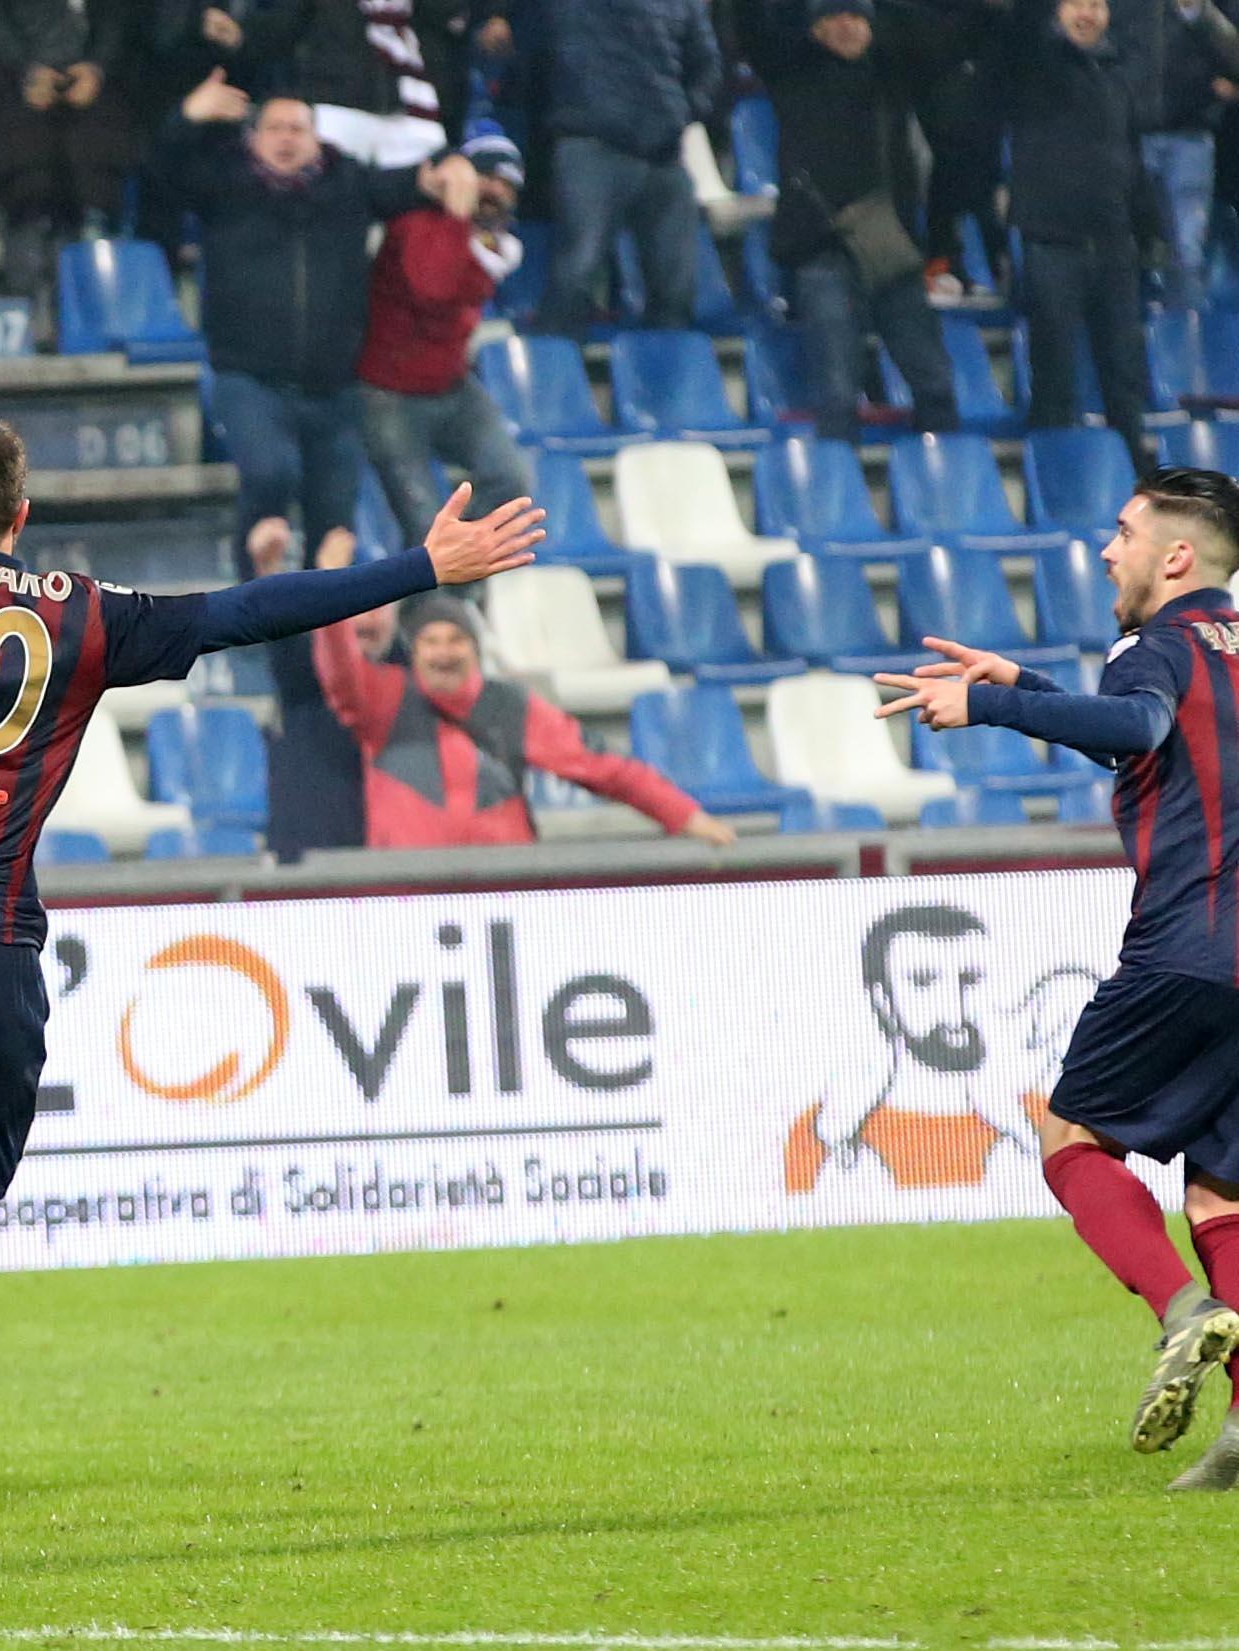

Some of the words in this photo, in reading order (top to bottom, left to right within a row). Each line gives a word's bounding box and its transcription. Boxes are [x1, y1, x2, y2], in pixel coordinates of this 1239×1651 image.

[77, 424, 107, 465] D
[230, 1162, 261, 1215] di
[525, 1145, 666, 1201] Sociale
